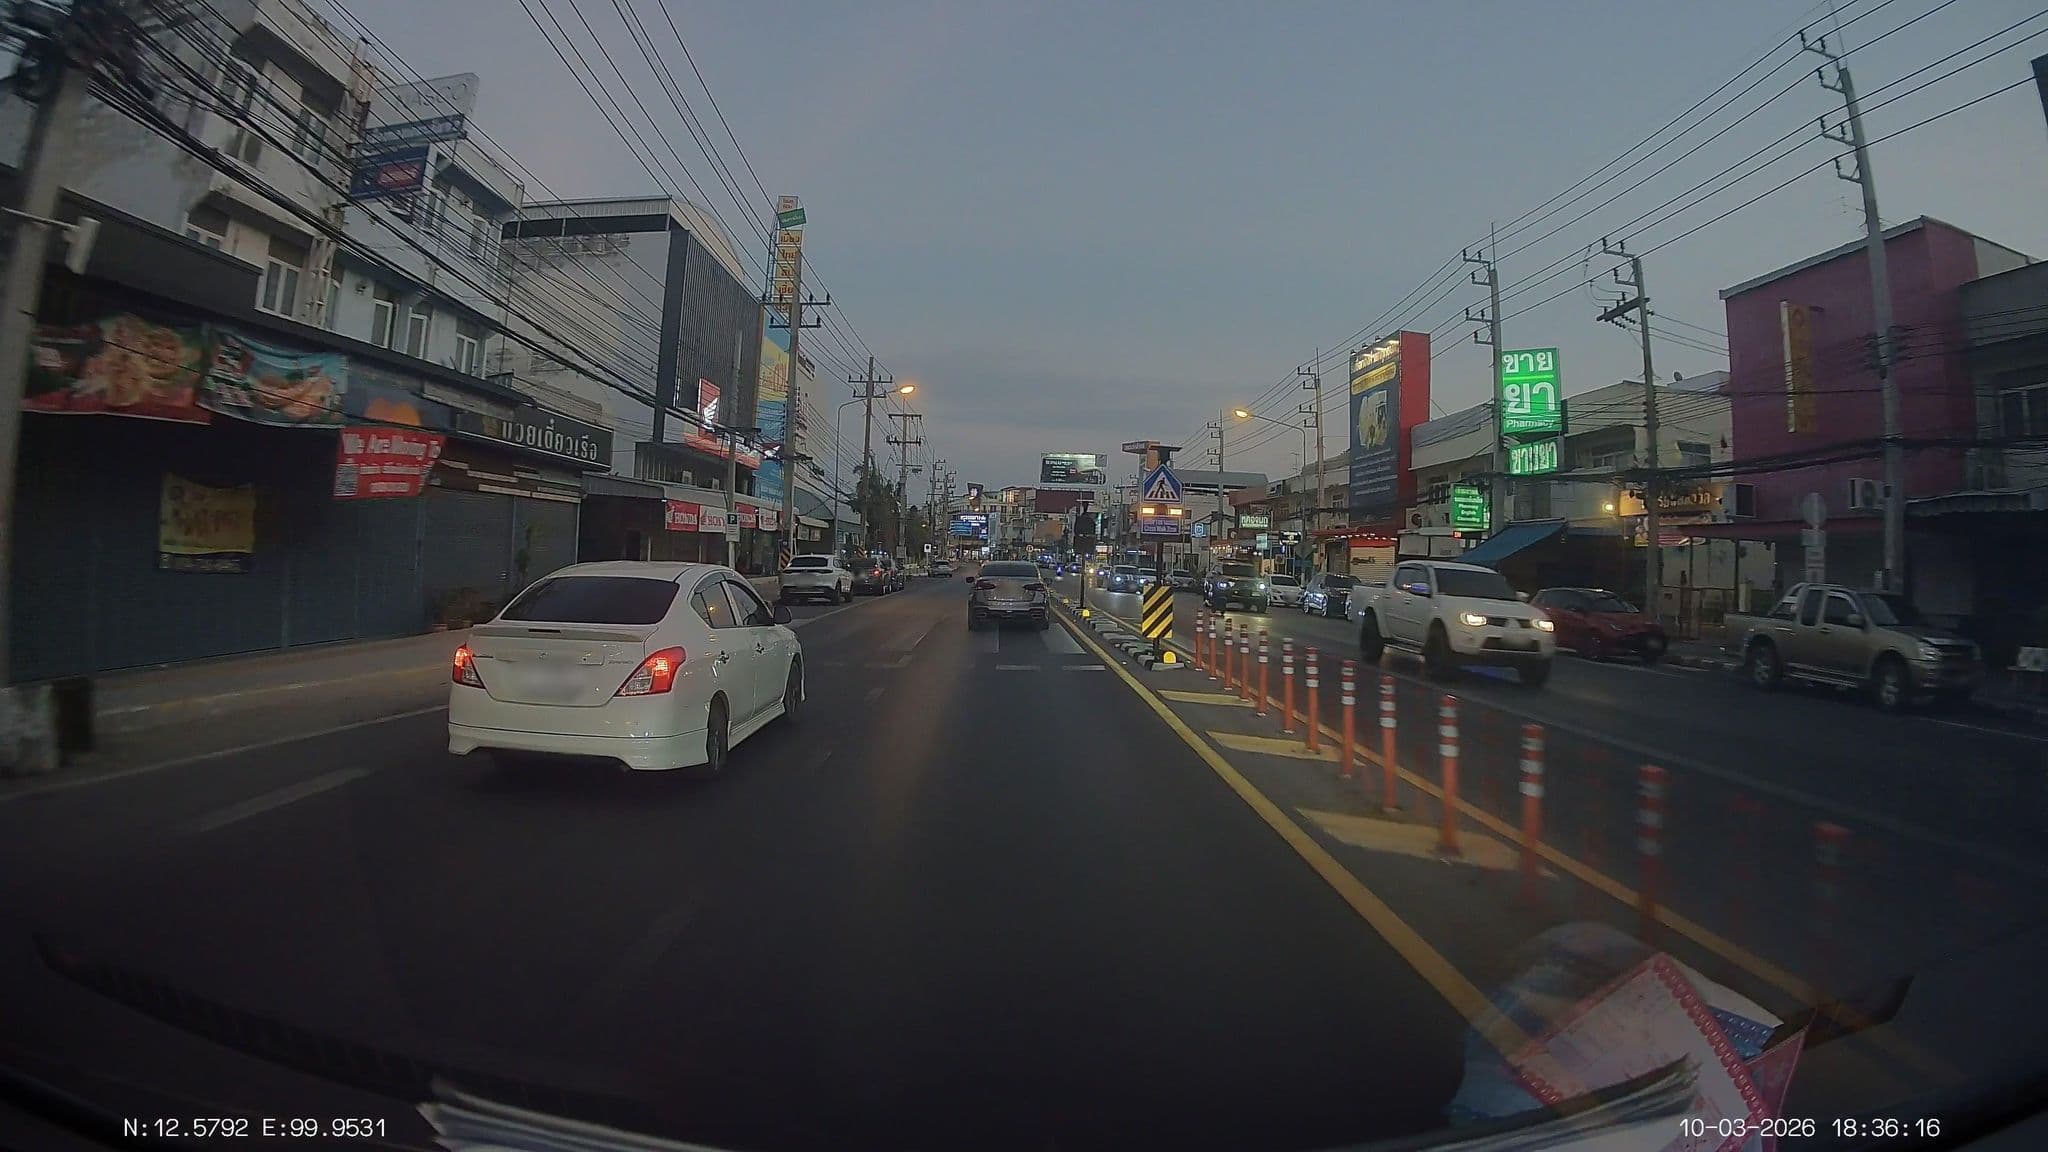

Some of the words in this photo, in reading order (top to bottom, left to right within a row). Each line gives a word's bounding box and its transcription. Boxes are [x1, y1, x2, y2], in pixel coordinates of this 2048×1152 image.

[1503, 351, 1554, 373] ขาย
[1504, 381, 1556, 414] ยา
[1506, 419, 1554, 429] Pharmacy
[502, 417, 598, 461] กวยเตี๋ยวเรือ
[674, 513, 697, 525] HONDA
[730, 515, 736, 524] P
